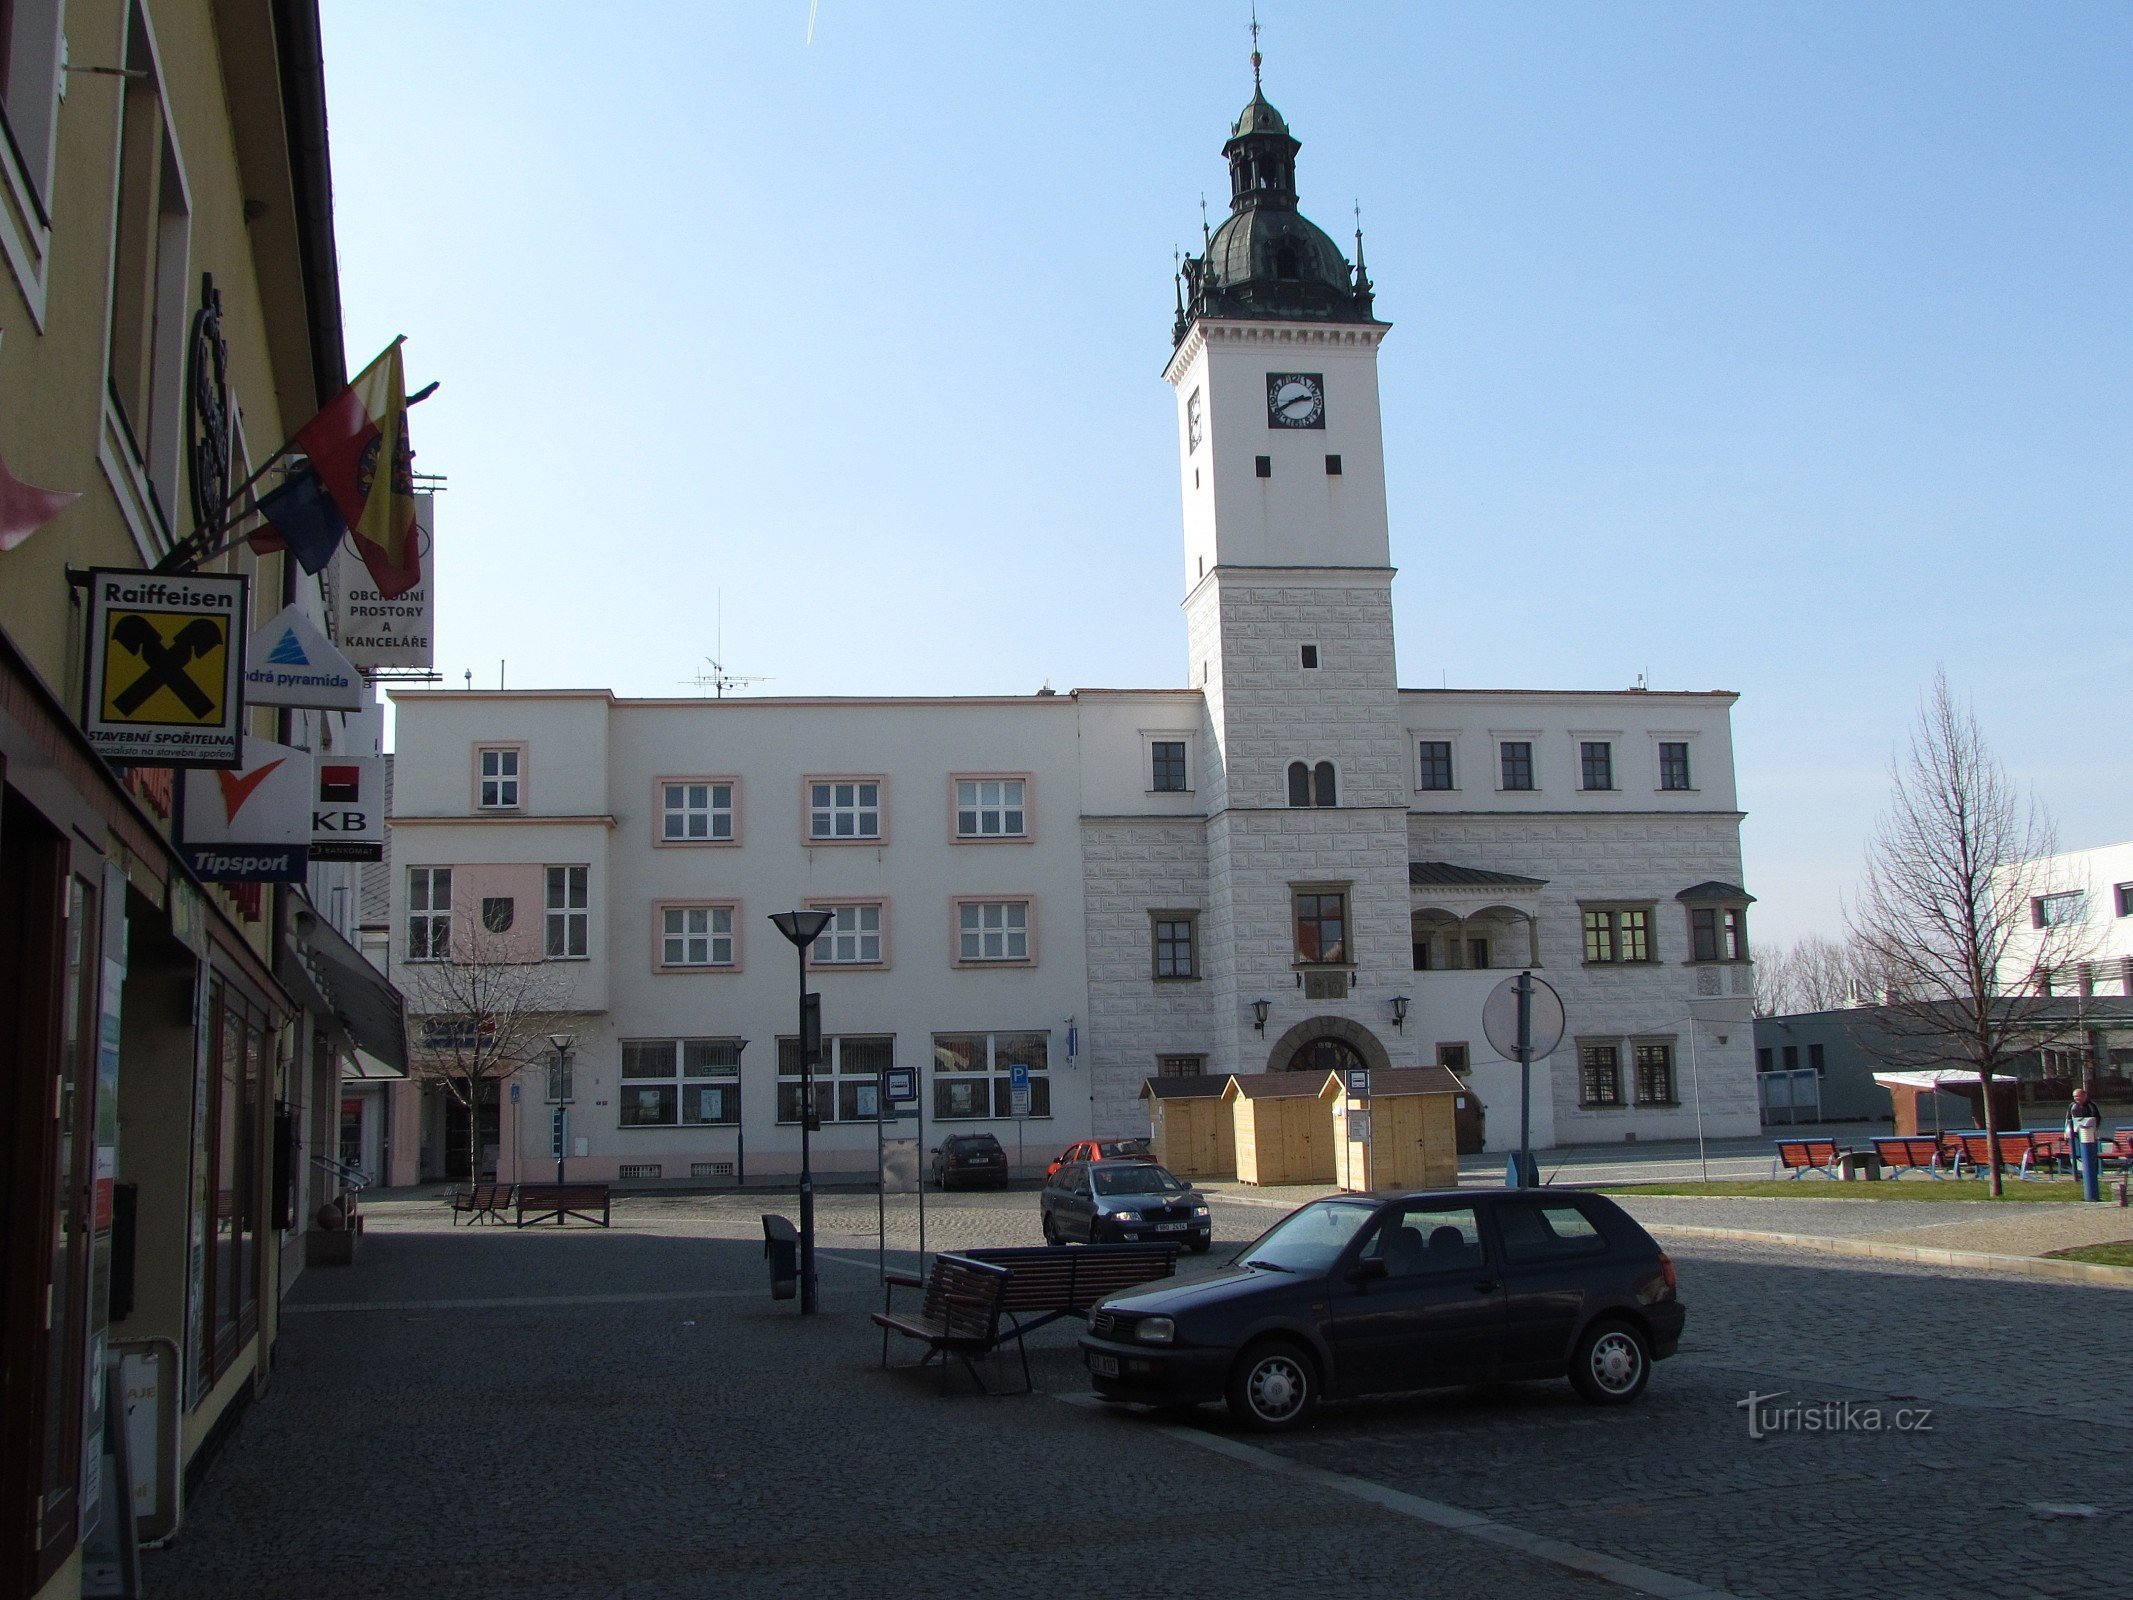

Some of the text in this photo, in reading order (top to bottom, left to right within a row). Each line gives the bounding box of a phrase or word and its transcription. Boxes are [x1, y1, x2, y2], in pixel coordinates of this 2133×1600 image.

[105, 582, 233, 608] Raiffeisen
[350, 606, 423, 617] PROSTORY
[382, 622, 391, 632] A
[345, 636, 428, 648] KANCELÁŘE
[277, 673, 349, 688] pyramida
[88, 731, 235, 746] STAVEBNÍ SPOŘITELNA
[312, 812, 367, 831] KB
[194, 852, 289, 875] Tipsport
[1013, 1067, 1024, 1082] P
